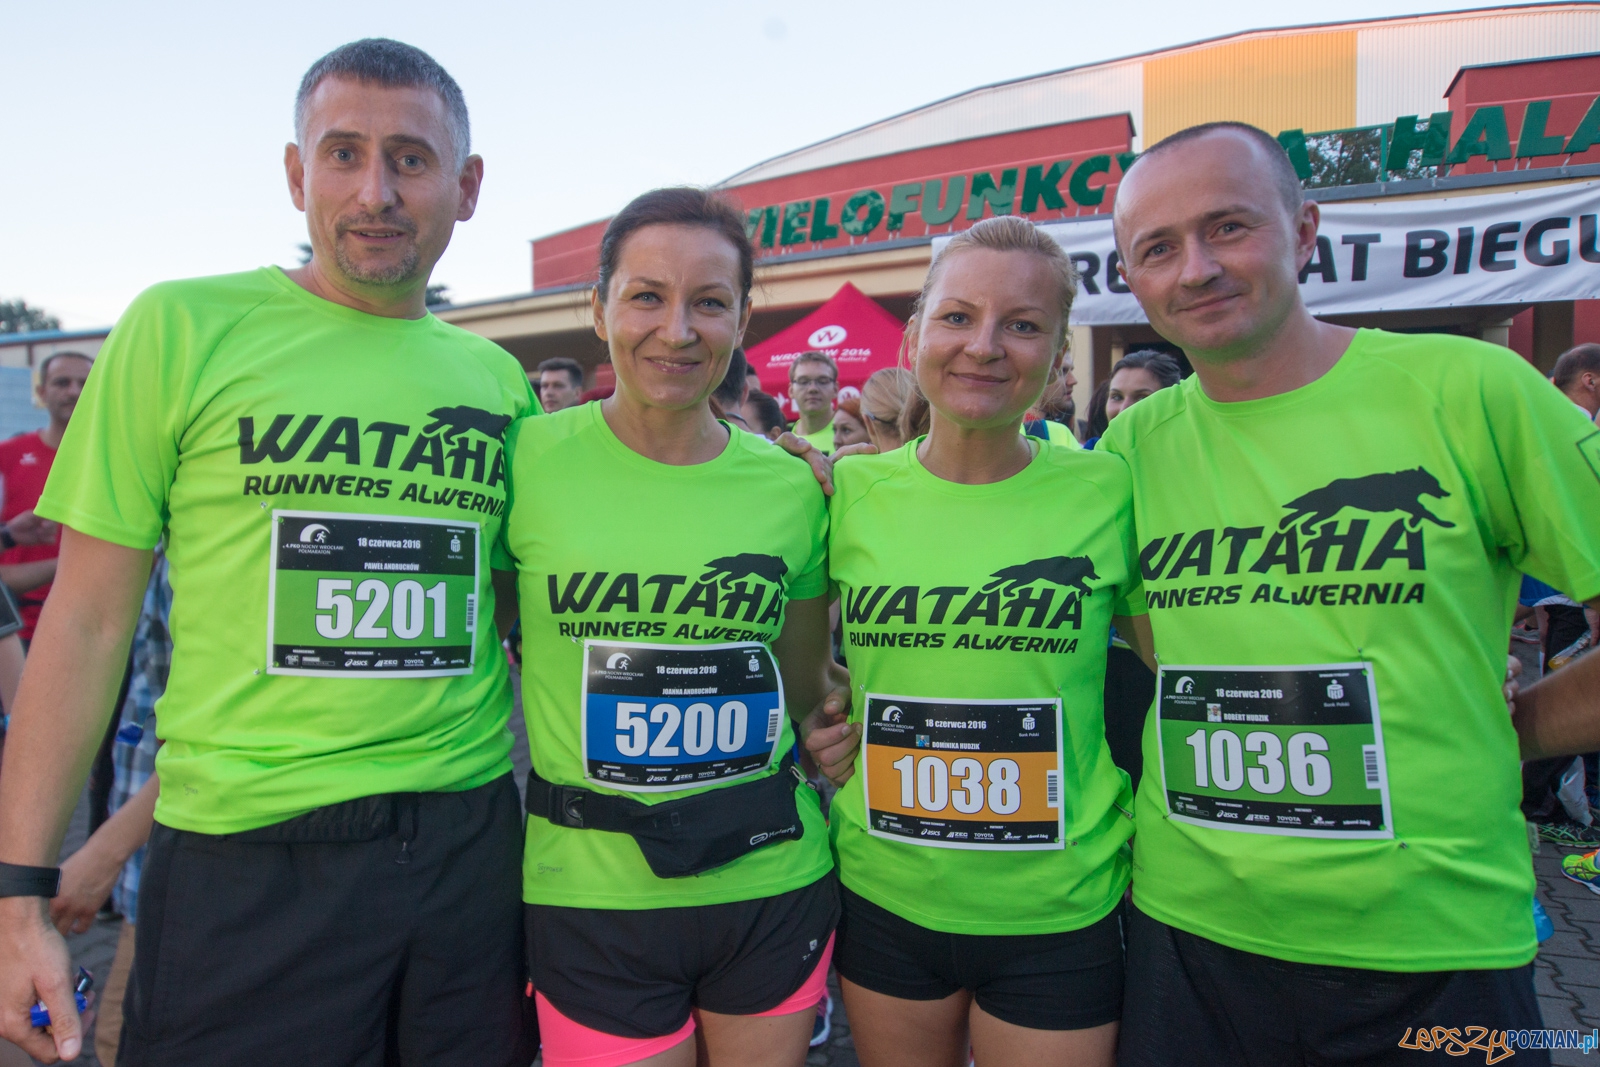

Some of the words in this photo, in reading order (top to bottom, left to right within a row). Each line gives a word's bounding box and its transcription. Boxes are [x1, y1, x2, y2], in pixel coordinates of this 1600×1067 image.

[841, 347, 872, 357] 2016
[238, 413, 507, 492] WATAHA
[243, 473, 393, 499] RUNNERS
[357, 537, 368, 547] 18
[368, 538, 402, 549] czerwca
[402, 539, 421, 549] 2016
[364, 562, 384, 570] PAWEŁ
[547, 571, 784, 627] WATAHA
[846, 585, 1083, 630] WATAHA
[1145, 583, 1243, 610] NNERS
[1250, 582, 1425, 606] ALWERNIA
[314, 577, 447, 640] 5201
[558, 620, 668, 638] RUNNERS
[849, 631, 946, 648] RUNNERS
[952, 633, 1079, 654] ALWERNIA
[656, 665, 666, 674] 18
[666, 666, 698, 675] czerwca
[699, 665, 718, 675] 2016
[1215, 688, 1225, 697] 18
[1225, 689, 1260, 699] czerwca
[1260, 688, 1283, 699] 2016
[614, 699, 749, 758] 5200
[924, 718, 934, 728] 18
[934, 720, 967, 729] czerwca
[967, 720, 987, 730] 2016
[932, 741, 959, 750] DOMINIKA
[960, 742, 980, 750] HUDZIK
[1185, 727, 1333, 798] 1036
[892, 754, 1022, 815] 1038
